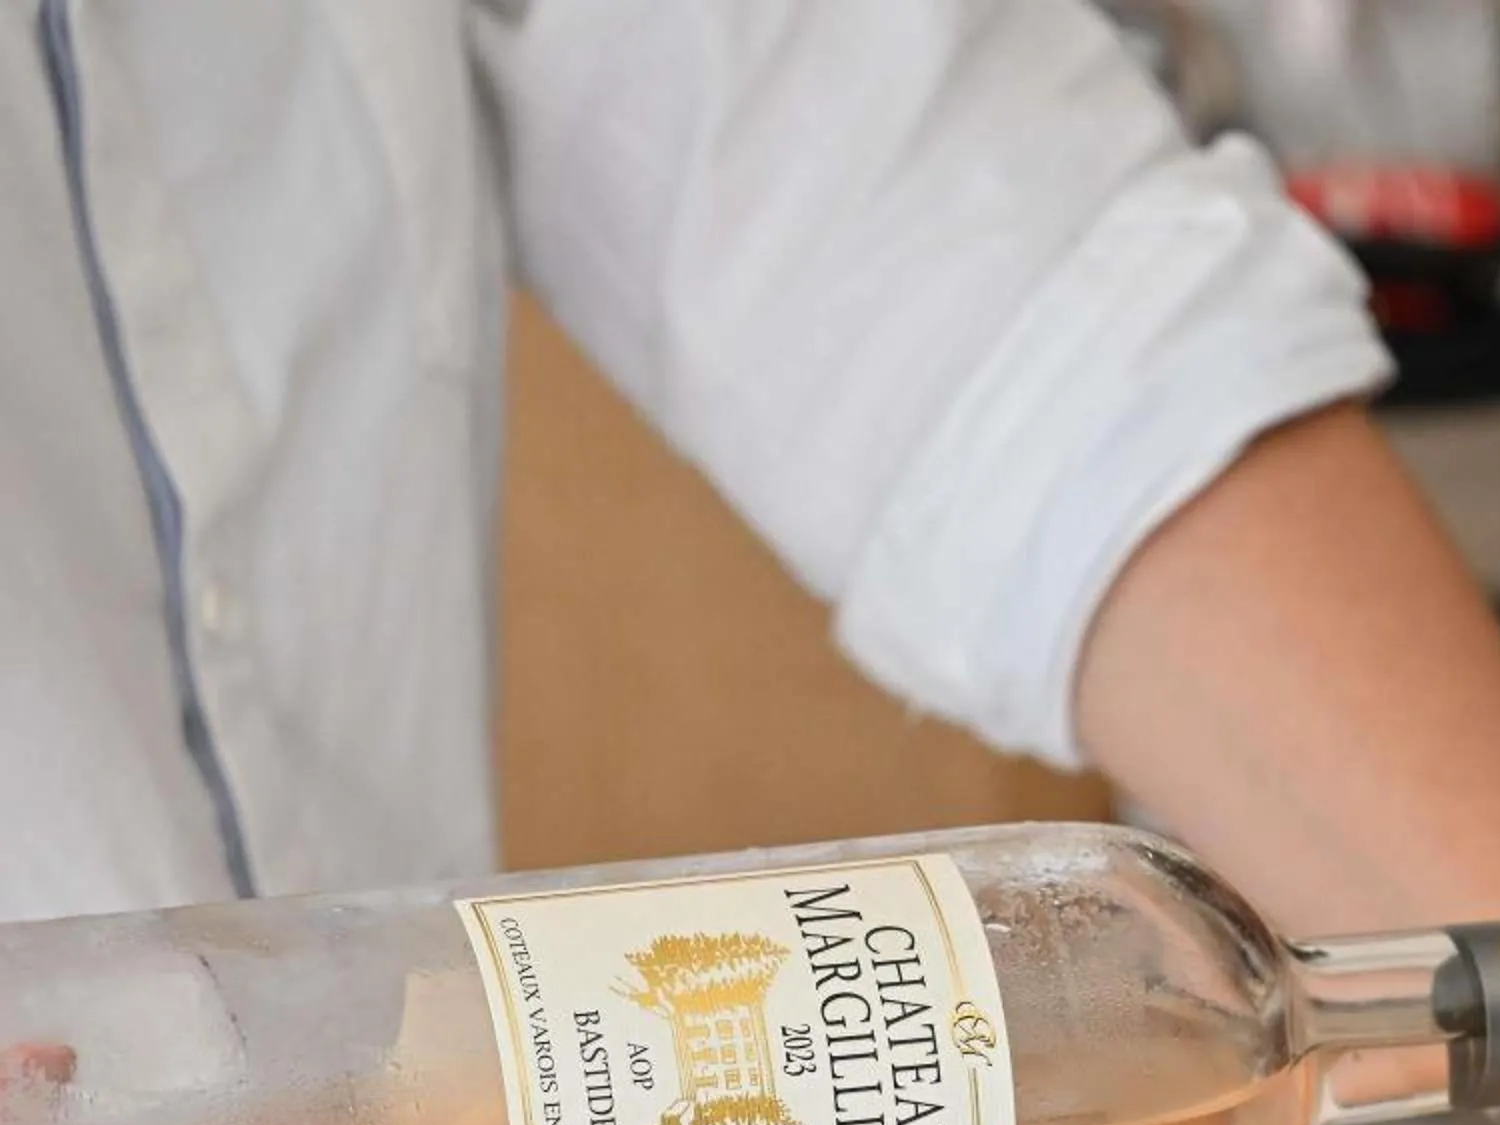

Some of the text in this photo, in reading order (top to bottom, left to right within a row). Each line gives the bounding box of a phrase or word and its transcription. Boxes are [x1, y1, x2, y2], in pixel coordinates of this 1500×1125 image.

[501, 917, 541, 1002] COTEAUX
[529, 1007, 558, 1093] VAROIS
[627, 1042, 654, 1090] AOP
[781, 1023, 817, 1077] 2023
